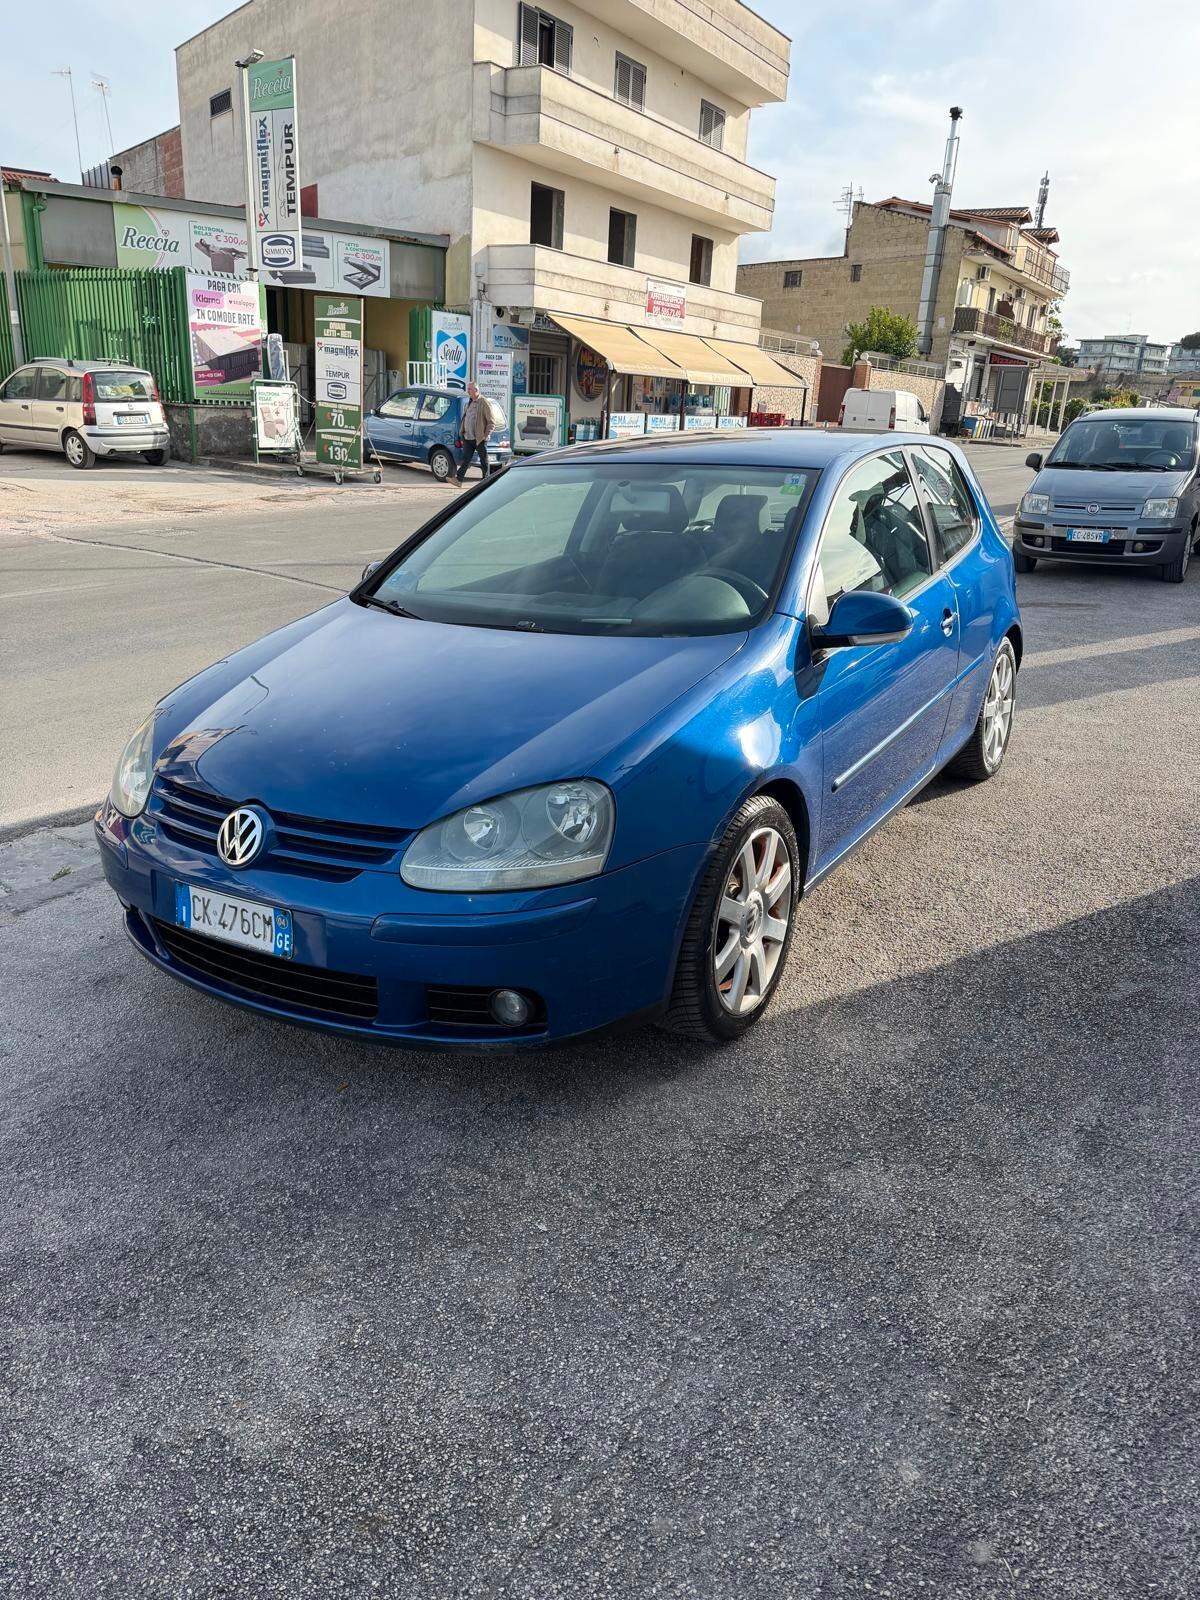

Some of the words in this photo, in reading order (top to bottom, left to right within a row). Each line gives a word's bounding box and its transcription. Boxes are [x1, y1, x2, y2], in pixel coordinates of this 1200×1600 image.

[252, 75, 292, 99] Reccia
[257, 115, 271, 208] magniflex
[284, 123, 297, 218] TEMPUR
[193, 224, 225, 233] POLTRONA
[121, 226, 180, 253] Reccia
[264, 247, 293, 257] SIMMONS
[207, 279, 227, 293] PAGA
[195, 293, 221, 305] Klarna
[196, 308, 206, 320] IN
[207, 310, 237, 324] COMODE
[238, 313, 255, 326] RATE
[324, 345, 359, 357] magniflex
[440, 343, 462, 365] Sealy
[325, 370, 350, 379] TEMPUR
[276, 932, 291, 951] GE
